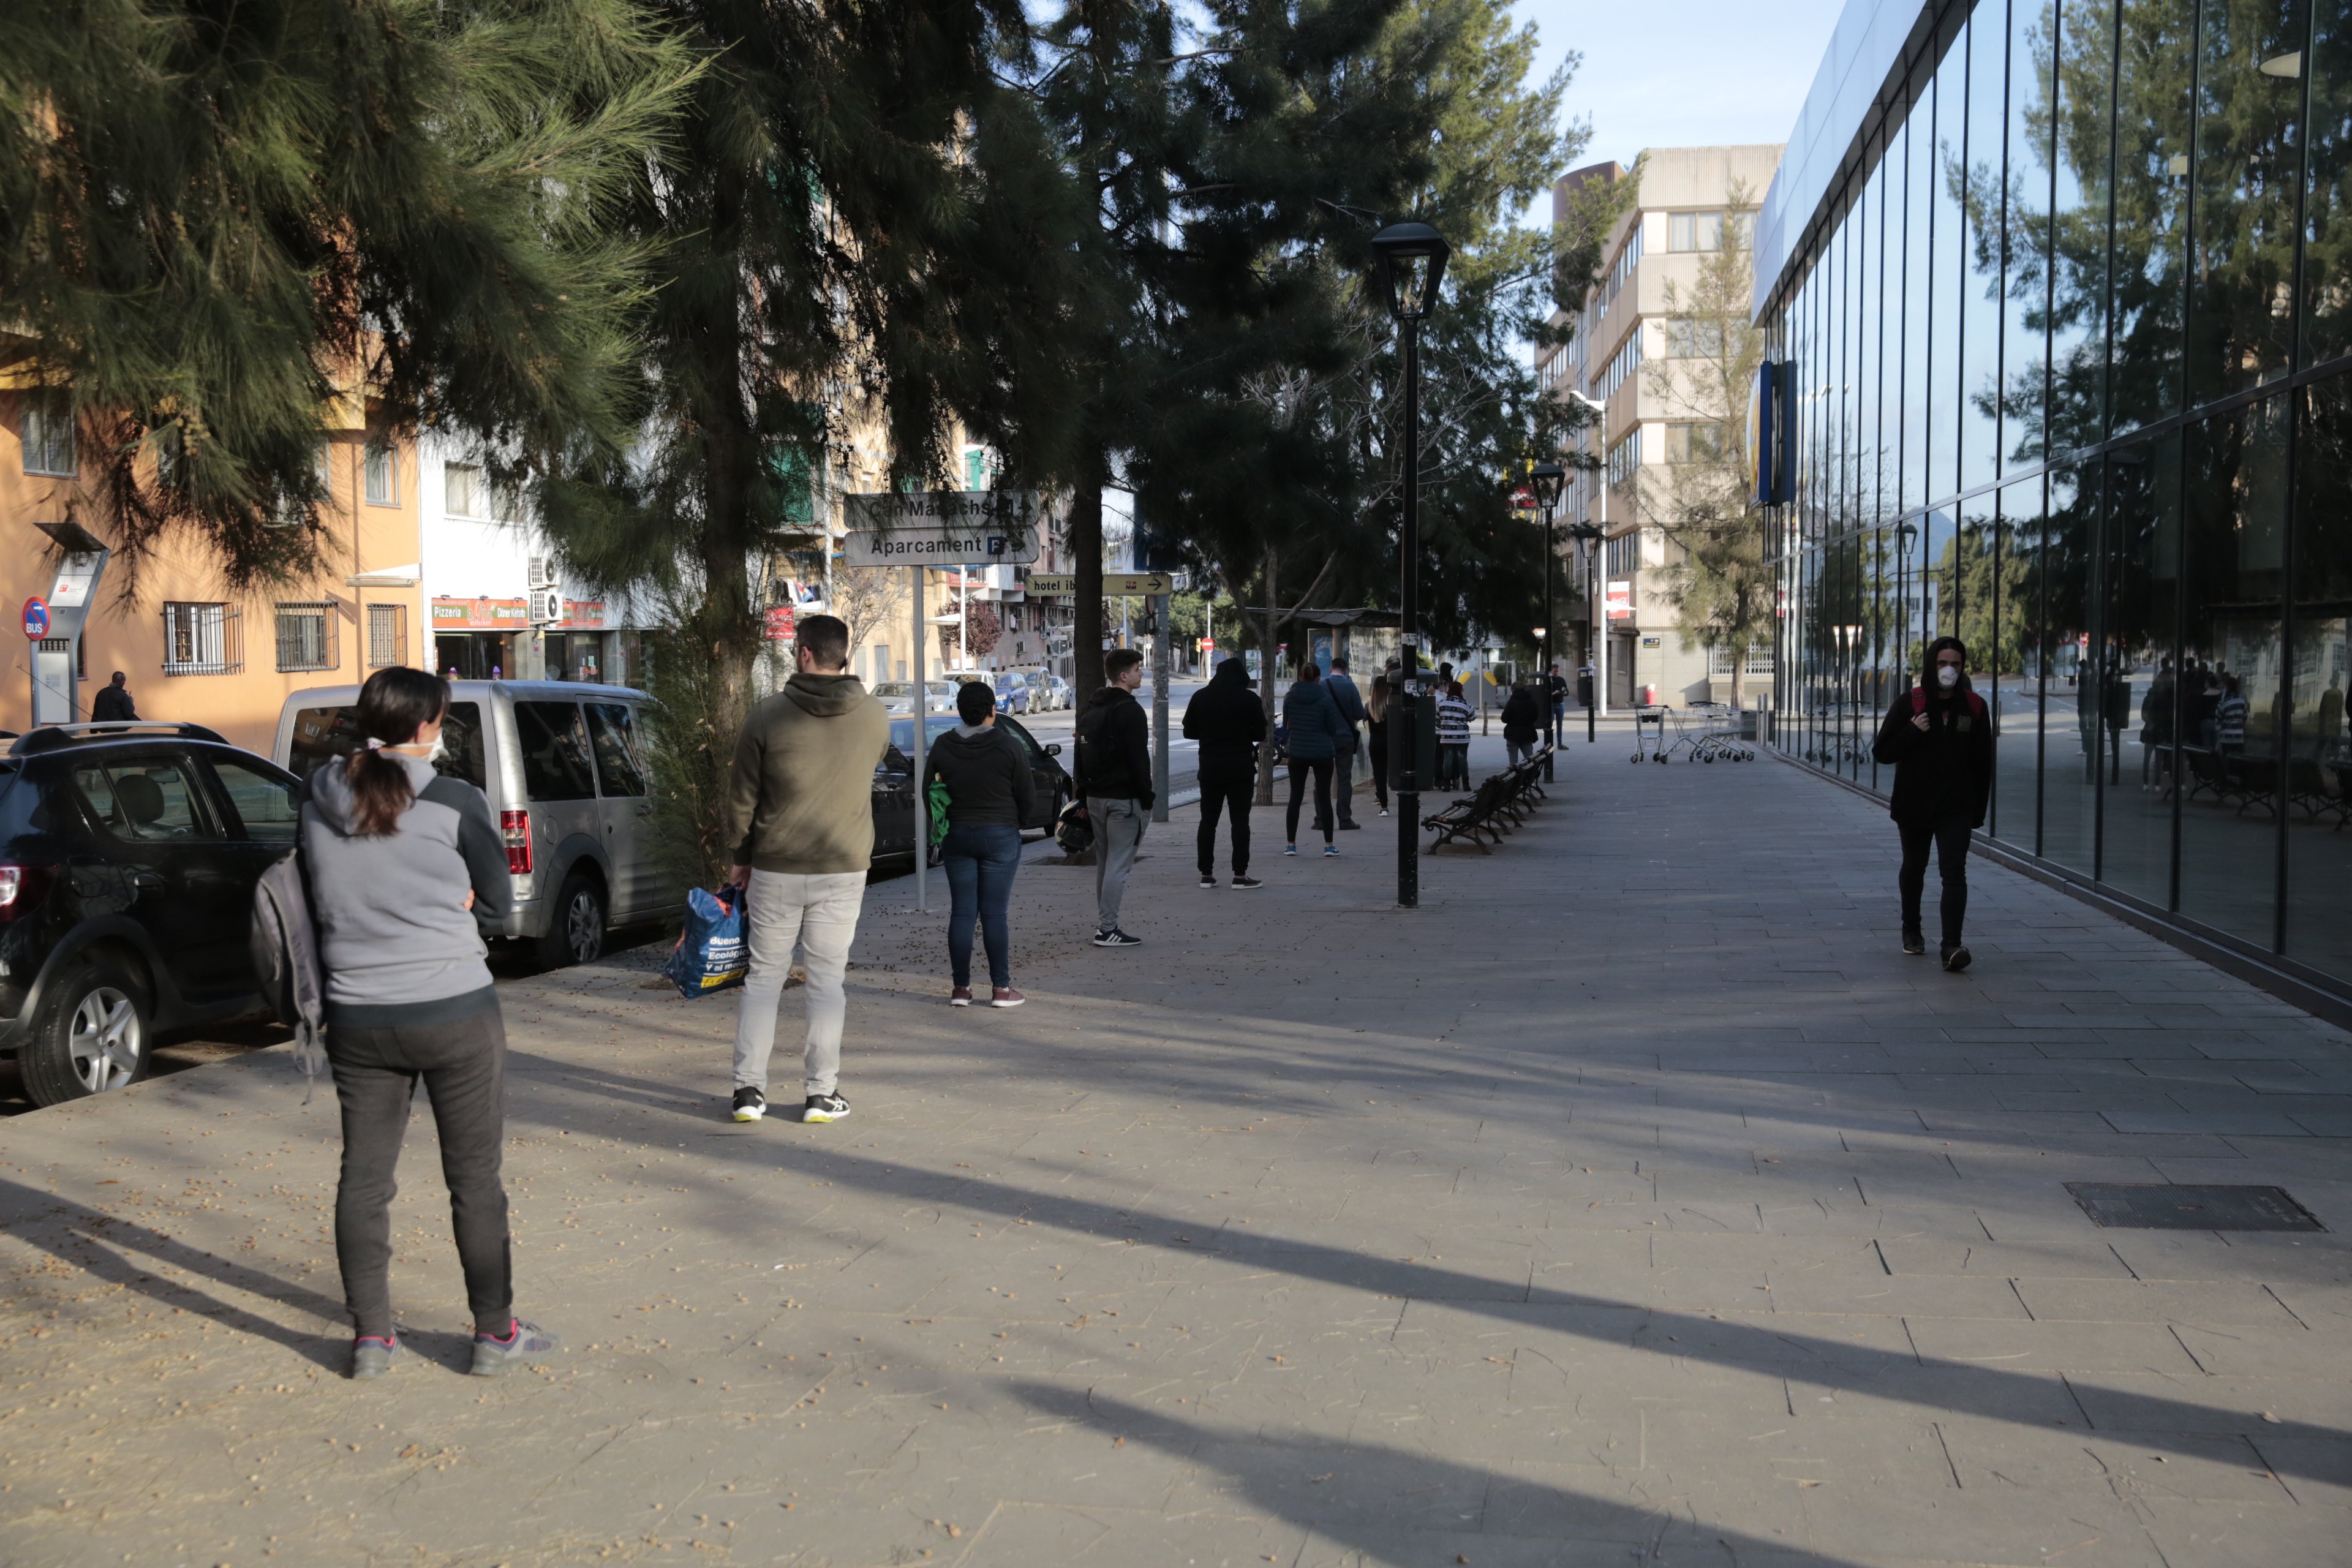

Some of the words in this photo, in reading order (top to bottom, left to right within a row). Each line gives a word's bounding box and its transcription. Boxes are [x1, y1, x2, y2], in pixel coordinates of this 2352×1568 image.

[871, 537, 981, 557] Aparcament
[1034, 580, 1060, 590] hotel
[1066, 580, 1076, 590] ib
[434, 606, 461, 617] Pizzeria
[497, 608, 510, 618] Döner
[511, 608, 526, 618] Kebab
[26, 623, 43, 633] BUS
